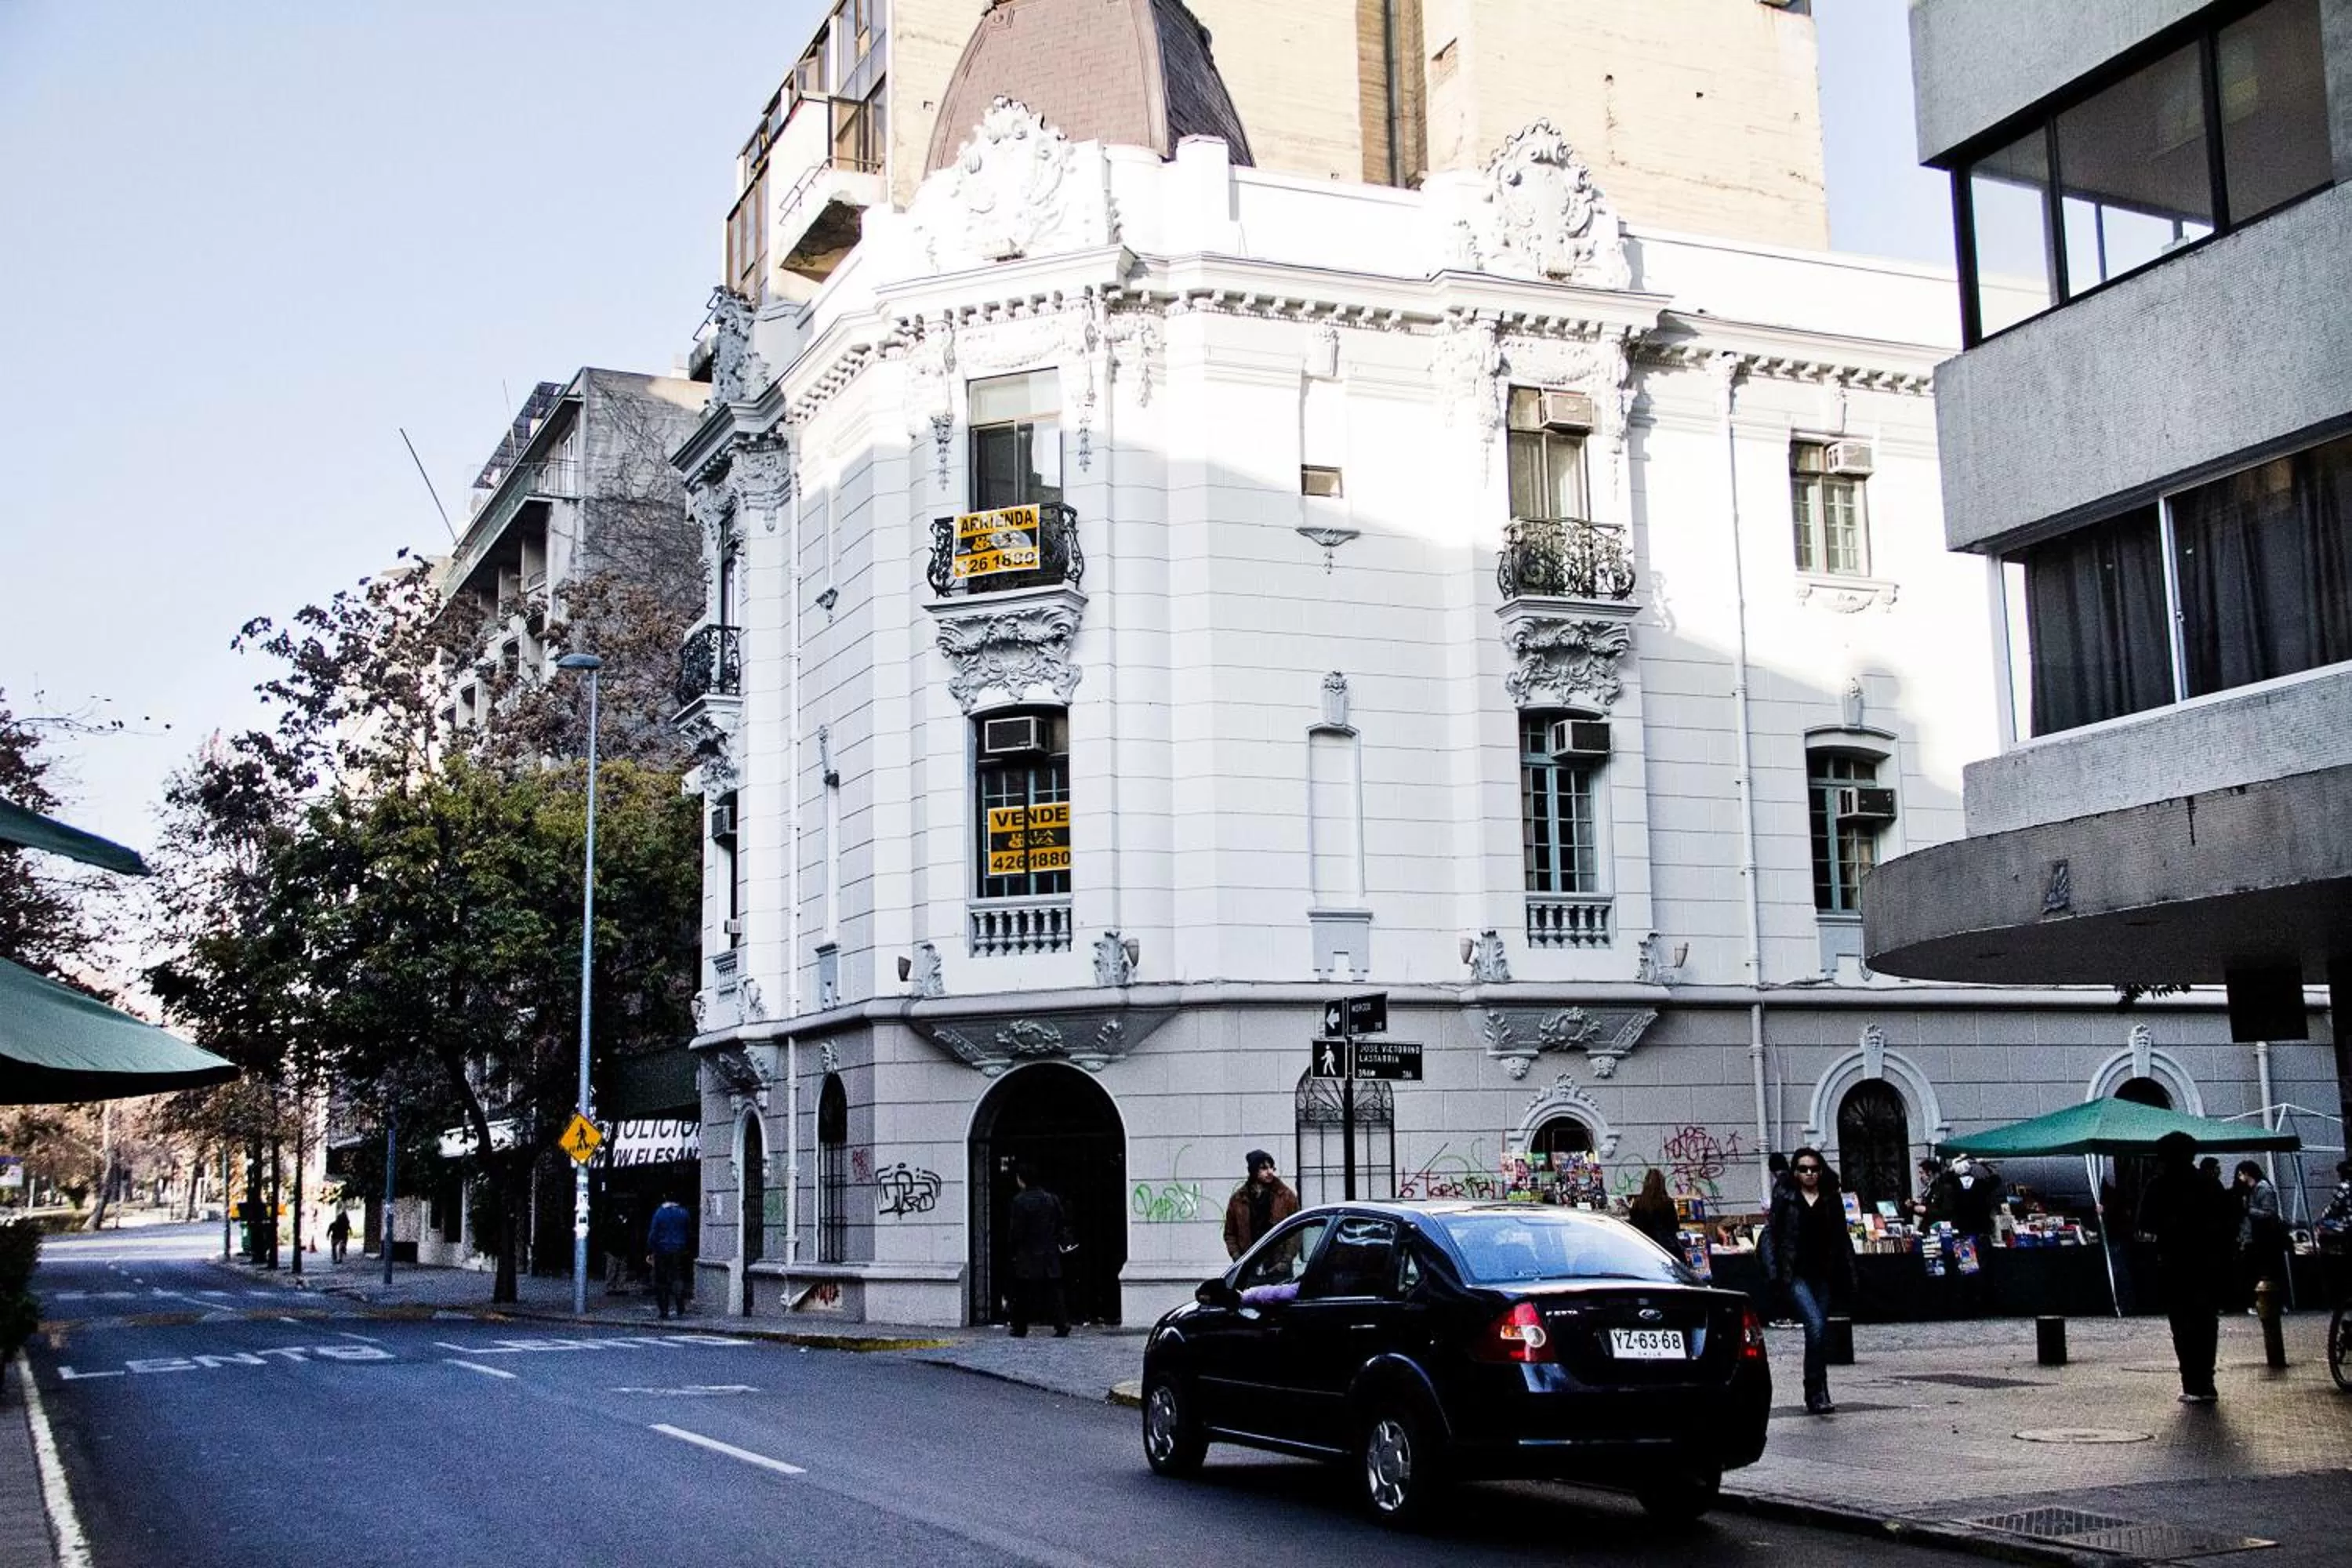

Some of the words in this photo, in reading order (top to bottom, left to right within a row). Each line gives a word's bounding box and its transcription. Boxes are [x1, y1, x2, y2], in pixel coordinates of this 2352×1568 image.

[960, 509, 1034, 534] ARRIENDA
[995, 806, 1069, 828] VENDE
[1359, 1054, 1399, 1064] LASTARRIA
[58, 1345, 394, 1380] LENTO
